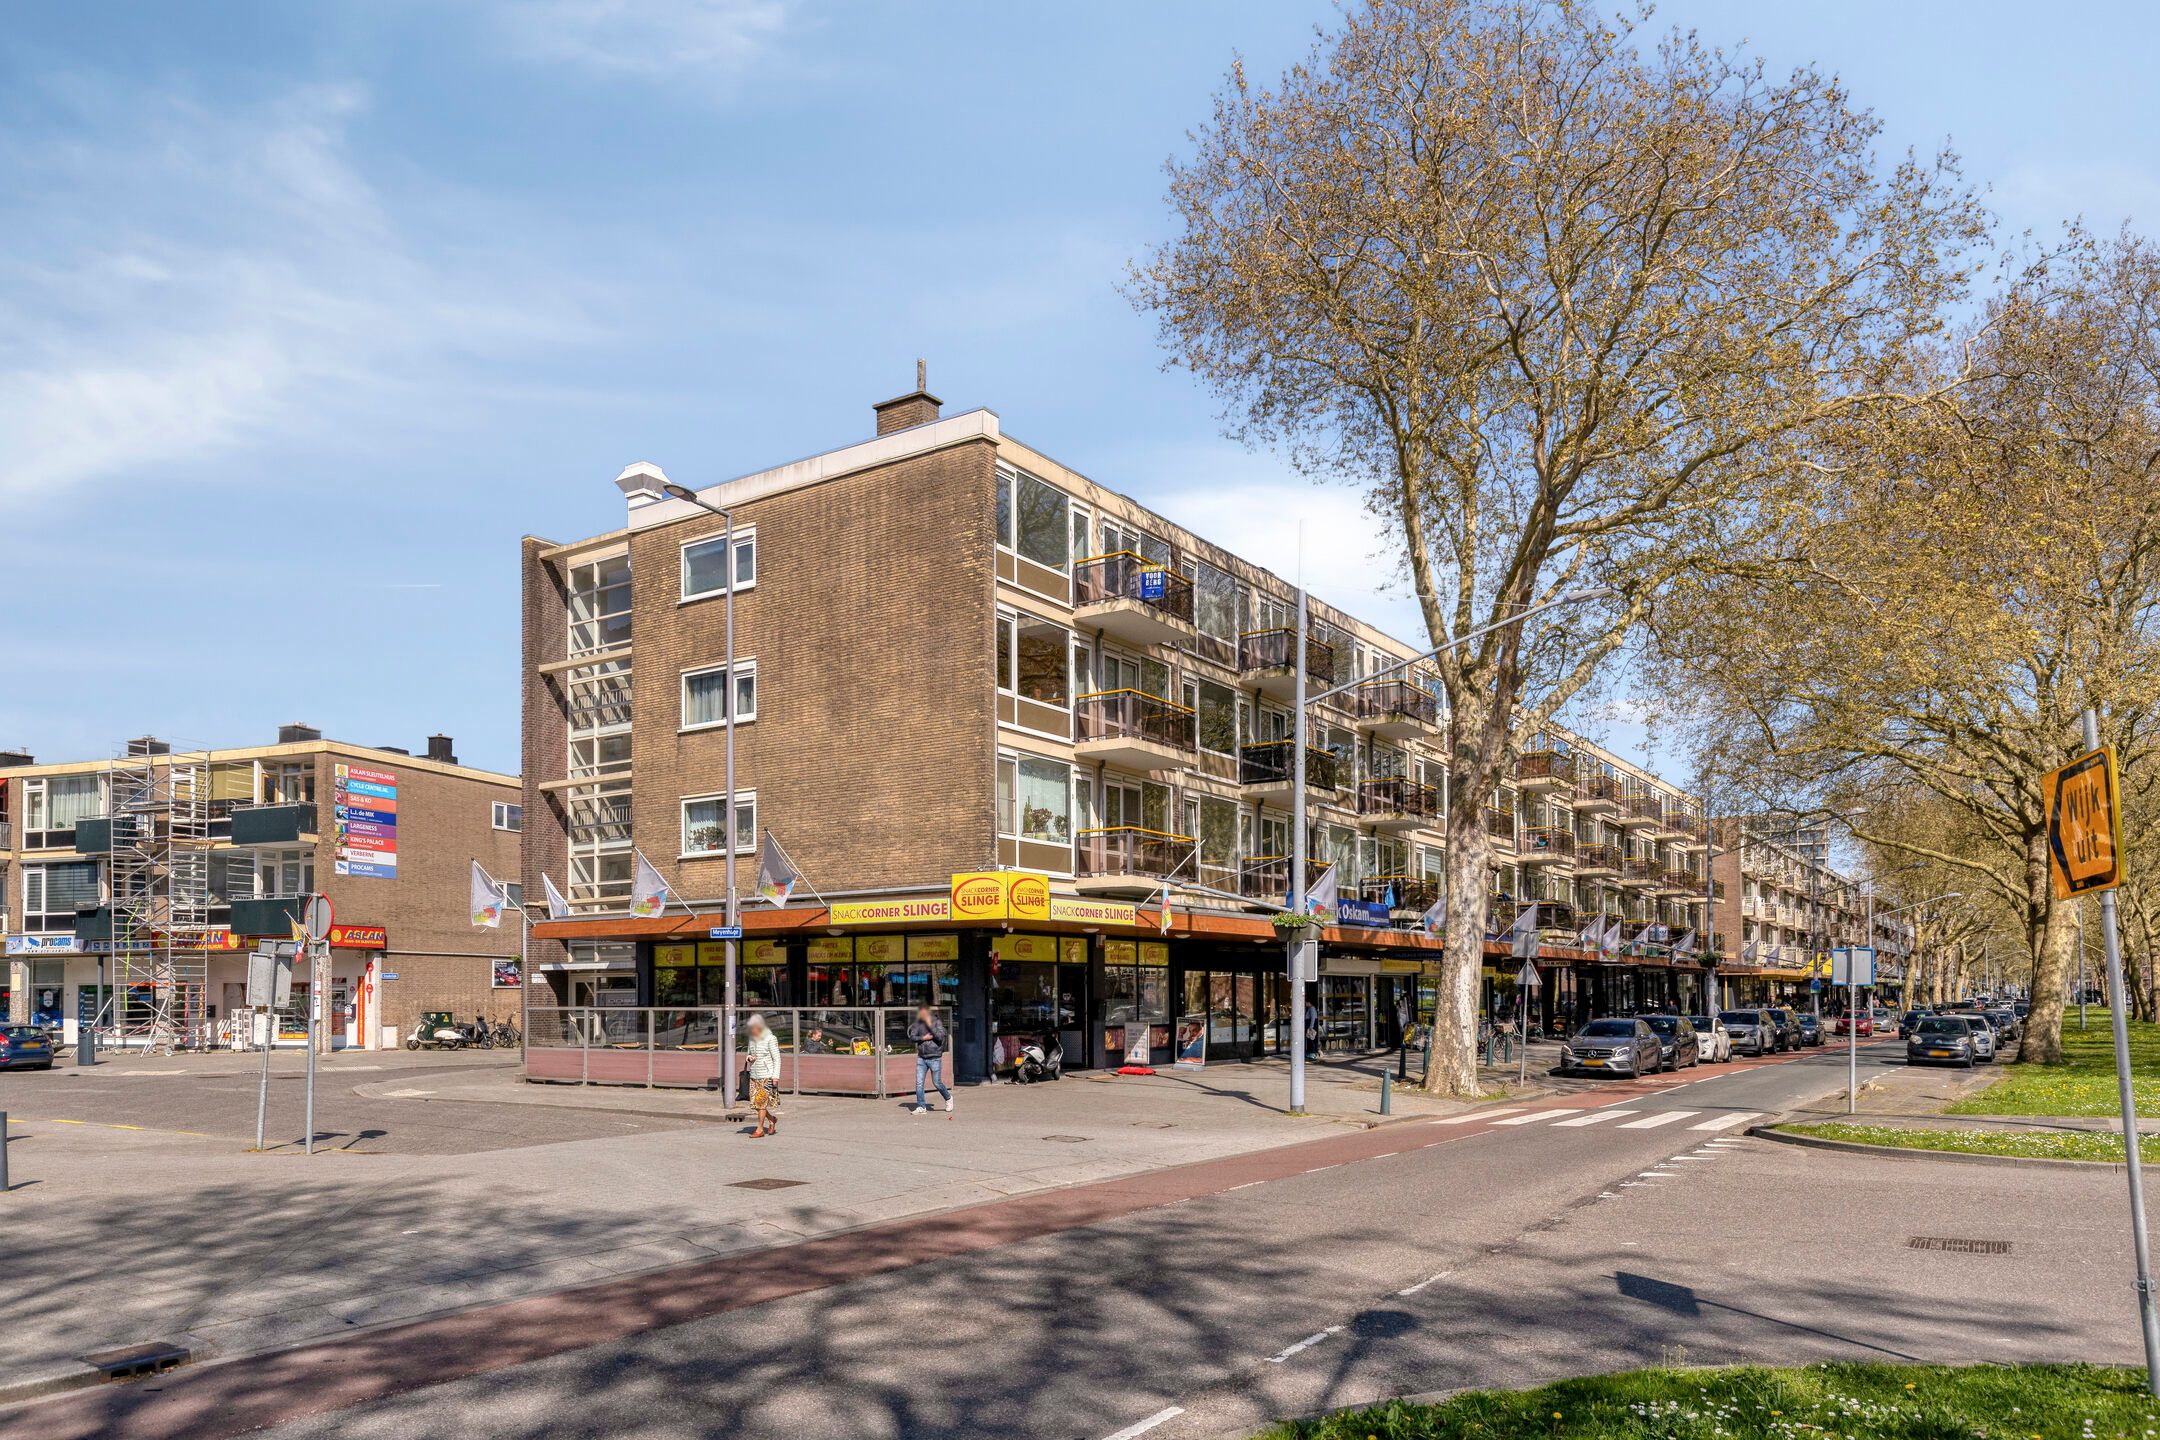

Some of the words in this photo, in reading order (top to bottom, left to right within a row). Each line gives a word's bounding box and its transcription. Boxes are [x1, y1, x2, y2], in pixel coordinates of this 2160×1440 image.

[350, 768, 366, 776] ASLAN
[2066, 782, 2100, 827] Wijk
[350, 823, 378, 831] LARGENESS
[367, 837, 384, 846] PALACE
[2077, 828, 2099, 864] uit
[350, 850, 375, 858] VERBERNE
[351, 863, 374, 871] PROCAMS
[961, 895, 1000, 906] SLINGE
[1016, 895, 1045, 907] SLINGE
[833, 907, 901, 920] SNACKCORNER
[903, 902, 948, 917] SLINGE
[1052, 905, 1104, 918] SNACKCORNER
[1104, 907, 1134, 921] SLINGE
[1342, 903, 1370, 921] Oskam
[344, 929, 385, 941] ASLAN
[41, 936, 72, 947] procams
